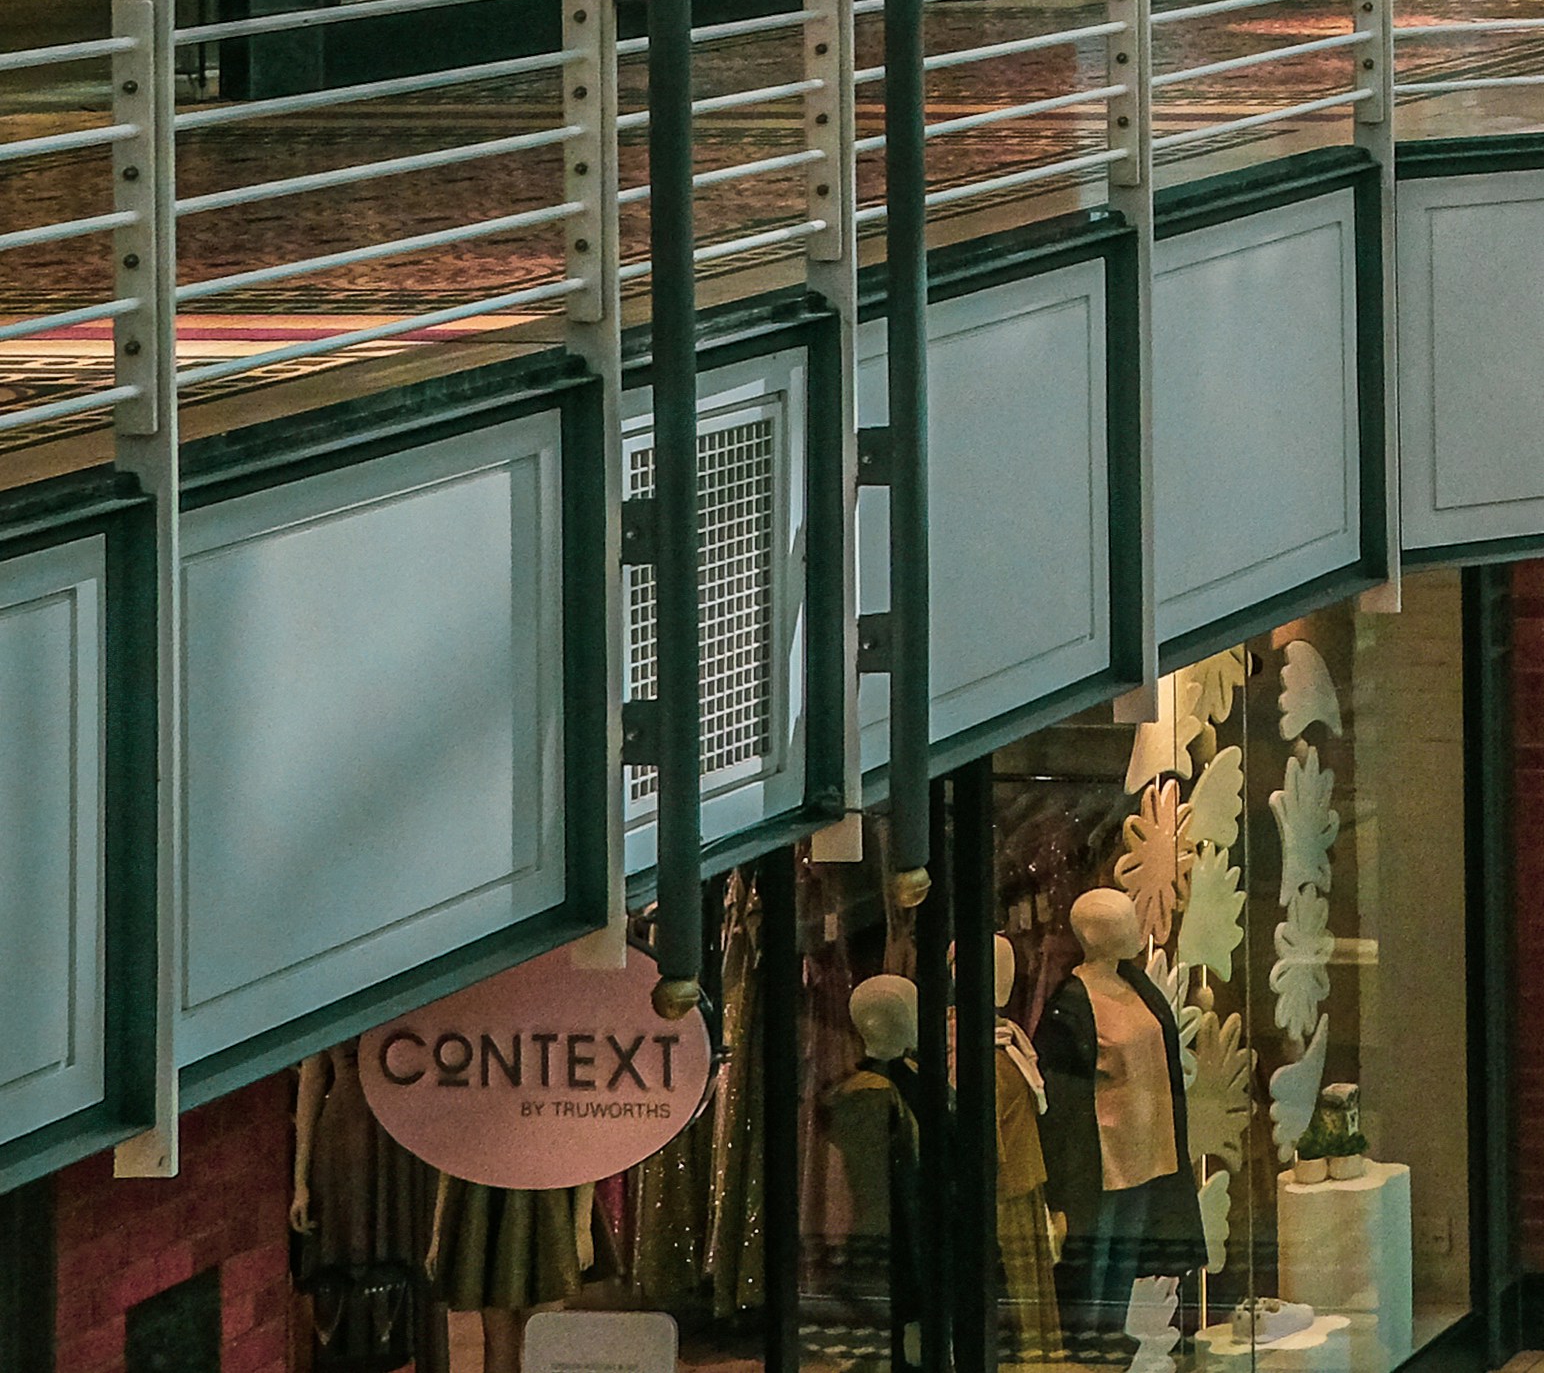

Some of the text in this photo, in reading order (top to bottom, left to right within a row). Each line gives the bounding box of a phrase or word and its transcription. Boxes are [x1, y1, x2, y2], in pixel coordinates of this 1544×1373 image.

[380, 1031, 681, 1092] CONTEXT
[520, 1101, 672, 1119] BY TRUWORTHS
